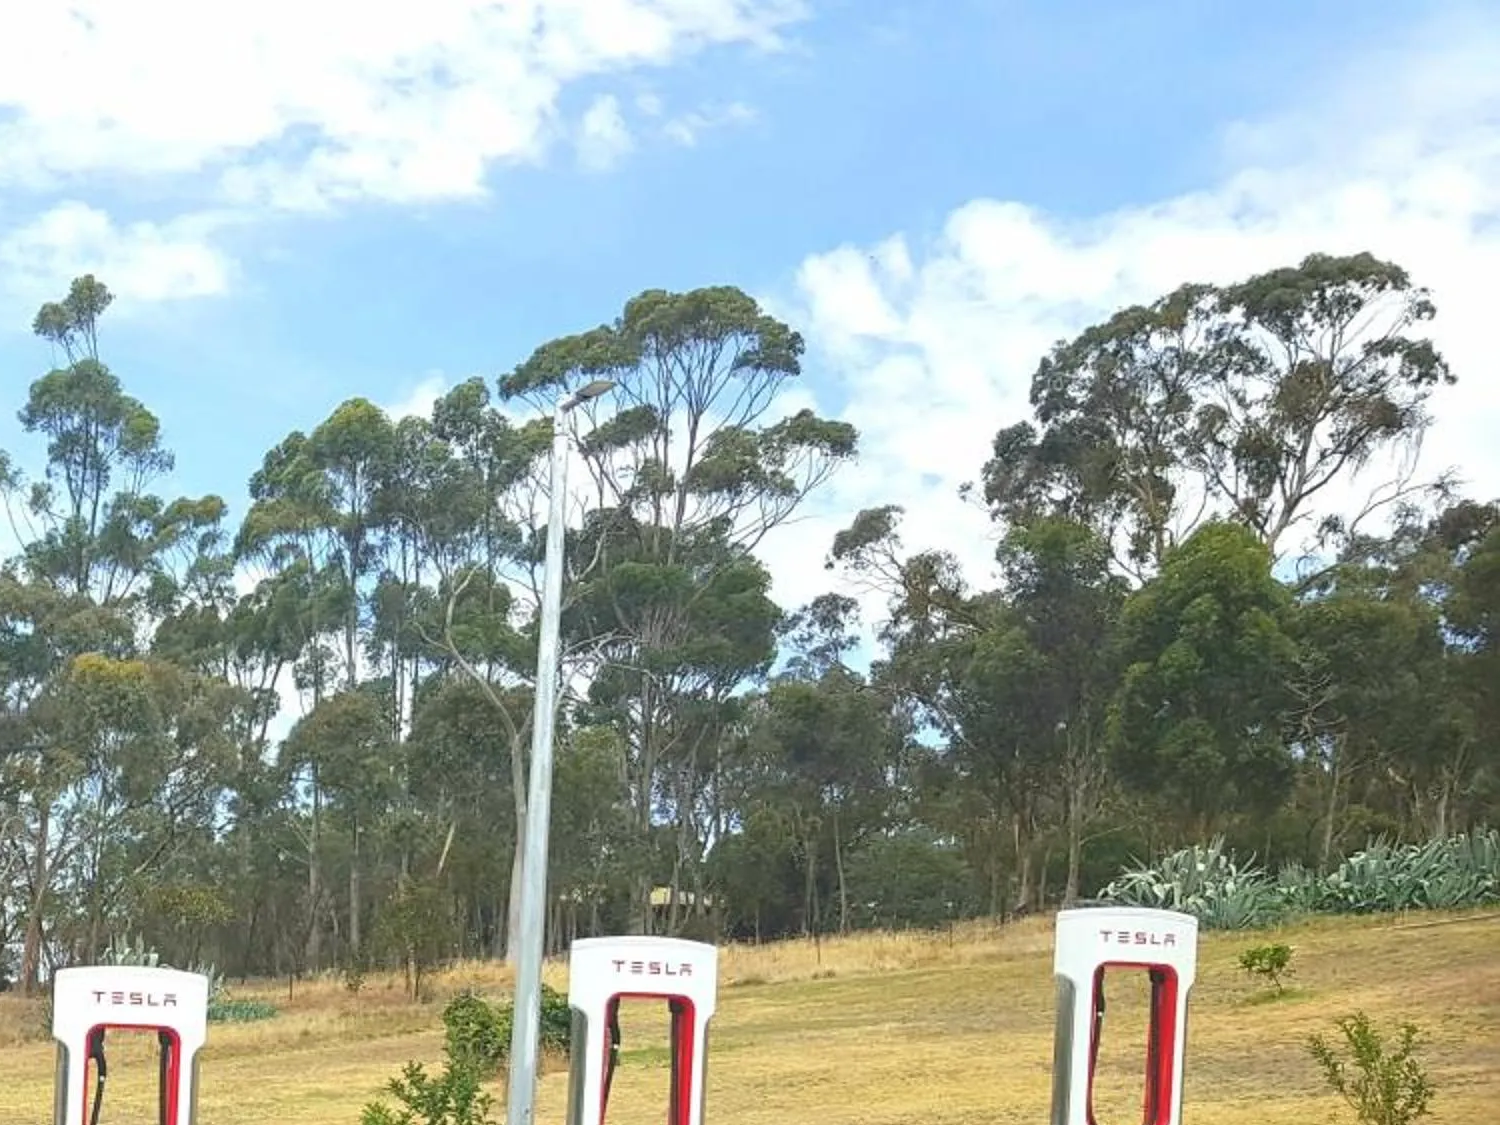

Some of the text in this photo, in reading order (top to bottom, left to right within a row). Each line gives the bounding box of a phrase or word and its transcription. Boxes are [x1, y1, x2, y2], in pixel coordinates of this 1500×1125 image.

[1099, 929, 1177, 947] TESLA
[611, 959, 693, 977] TESLA
[91, 990, 178, 1008] TESLA
